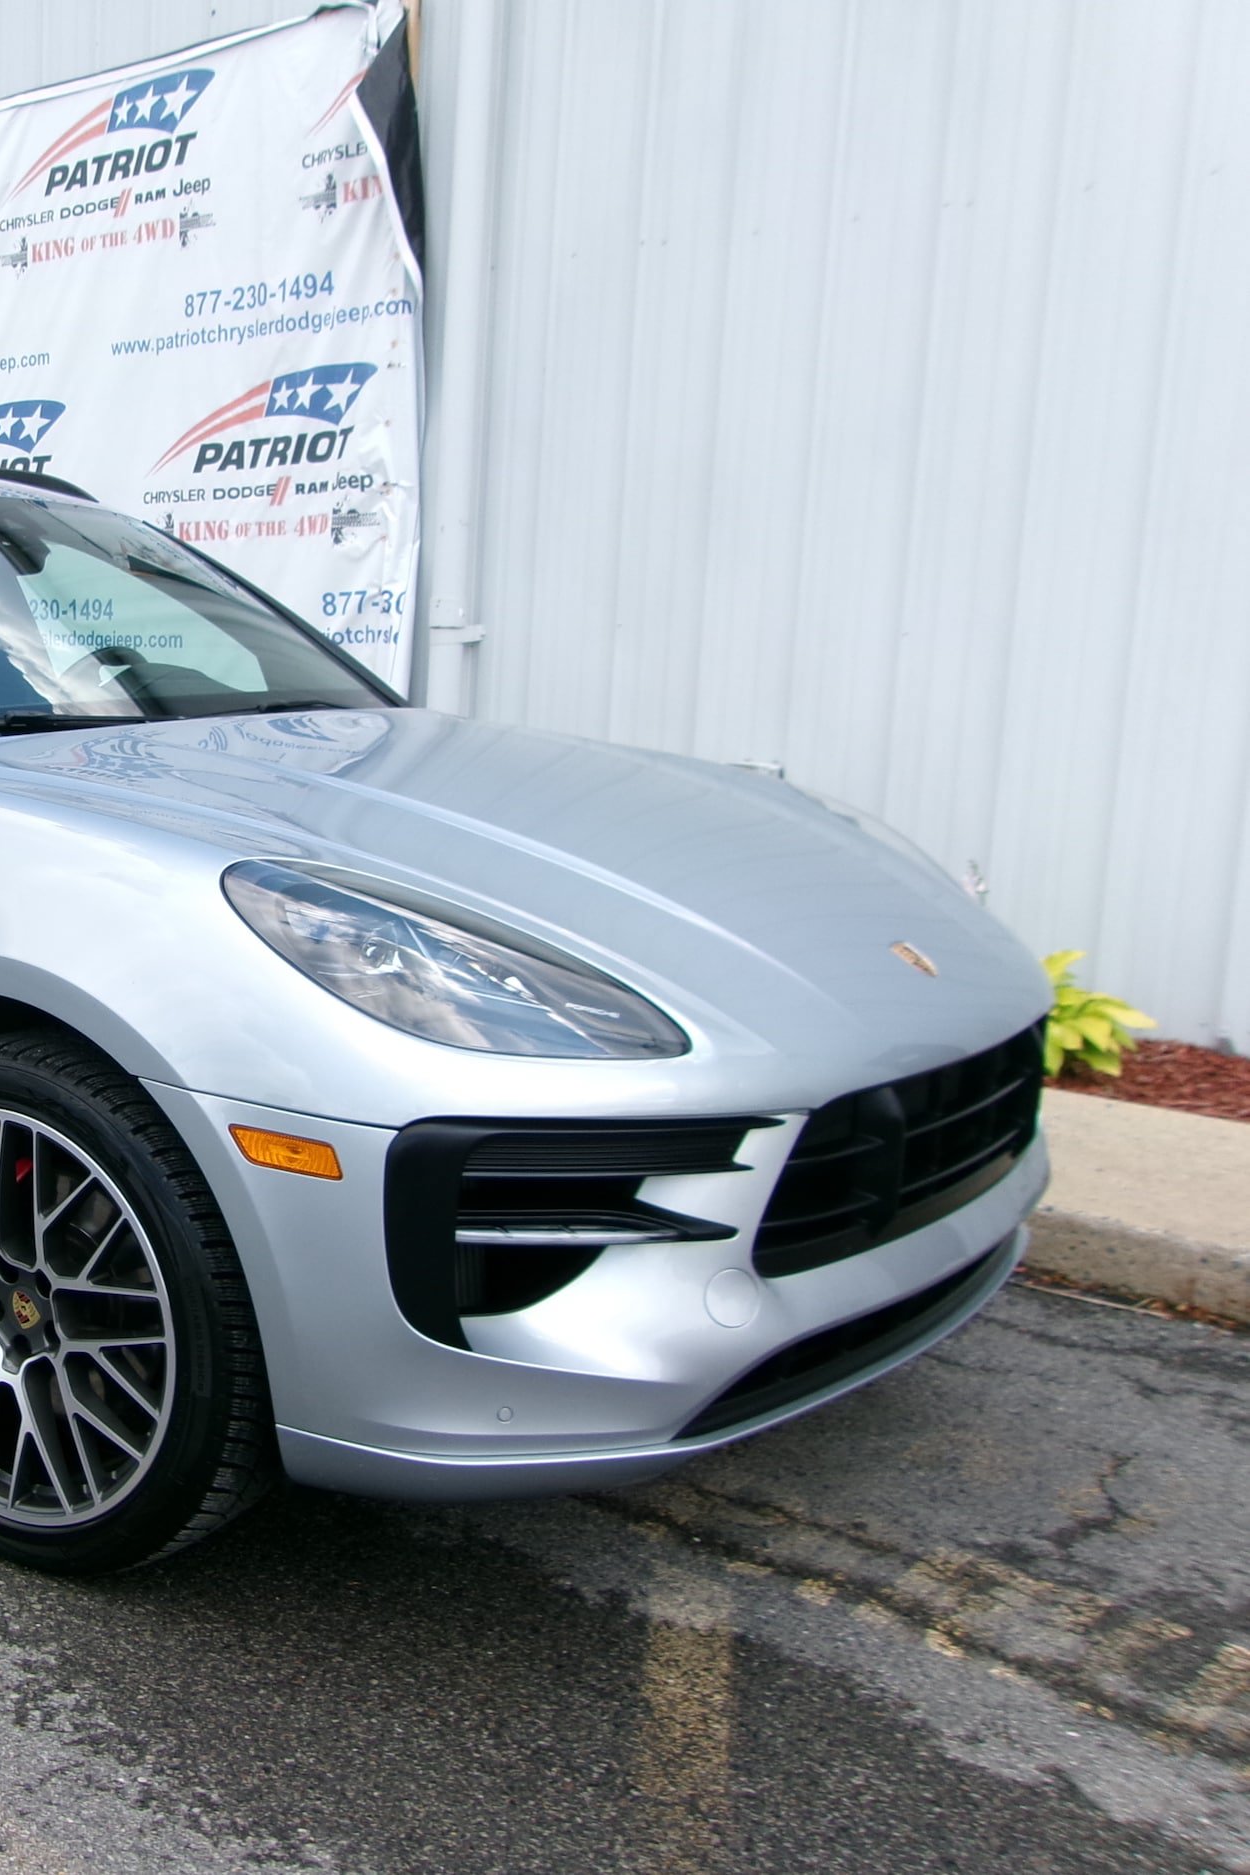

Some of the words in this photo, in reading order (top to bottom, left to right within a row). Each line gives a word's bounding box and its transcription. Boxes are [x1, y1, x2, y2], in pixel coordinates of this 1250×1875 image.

[45, 131, 198, 197] PATRIOT
[0, 210, 54, 232] CHRYSLER
[60, 196, 120, 220] DODGE
[134, 187, 166, 205] RAM
[173, 177, 212, 197] Jeep
[31, 236, 76, 264] KING
[81, 236, 97, 253] OF
[99, 229, 128, 249] THE
[132, 217, 176, 245] 4WD
[184, 270, 335, 318] 877-230-1494
[192, 425, 355, 473] PATRIOT
[143, 487, 206, 504] CHRYSLER
[212, 483, 276, 500] DODGE
[295, 480, 329, 495] RAM
[331, 472, 374, 492] Jeep
[178, 519, 230, 542] KING
[235, 521, 251, 539] OF
[254, 519, 287, 536] THE
[293, 512, 329, 536] 4WD
